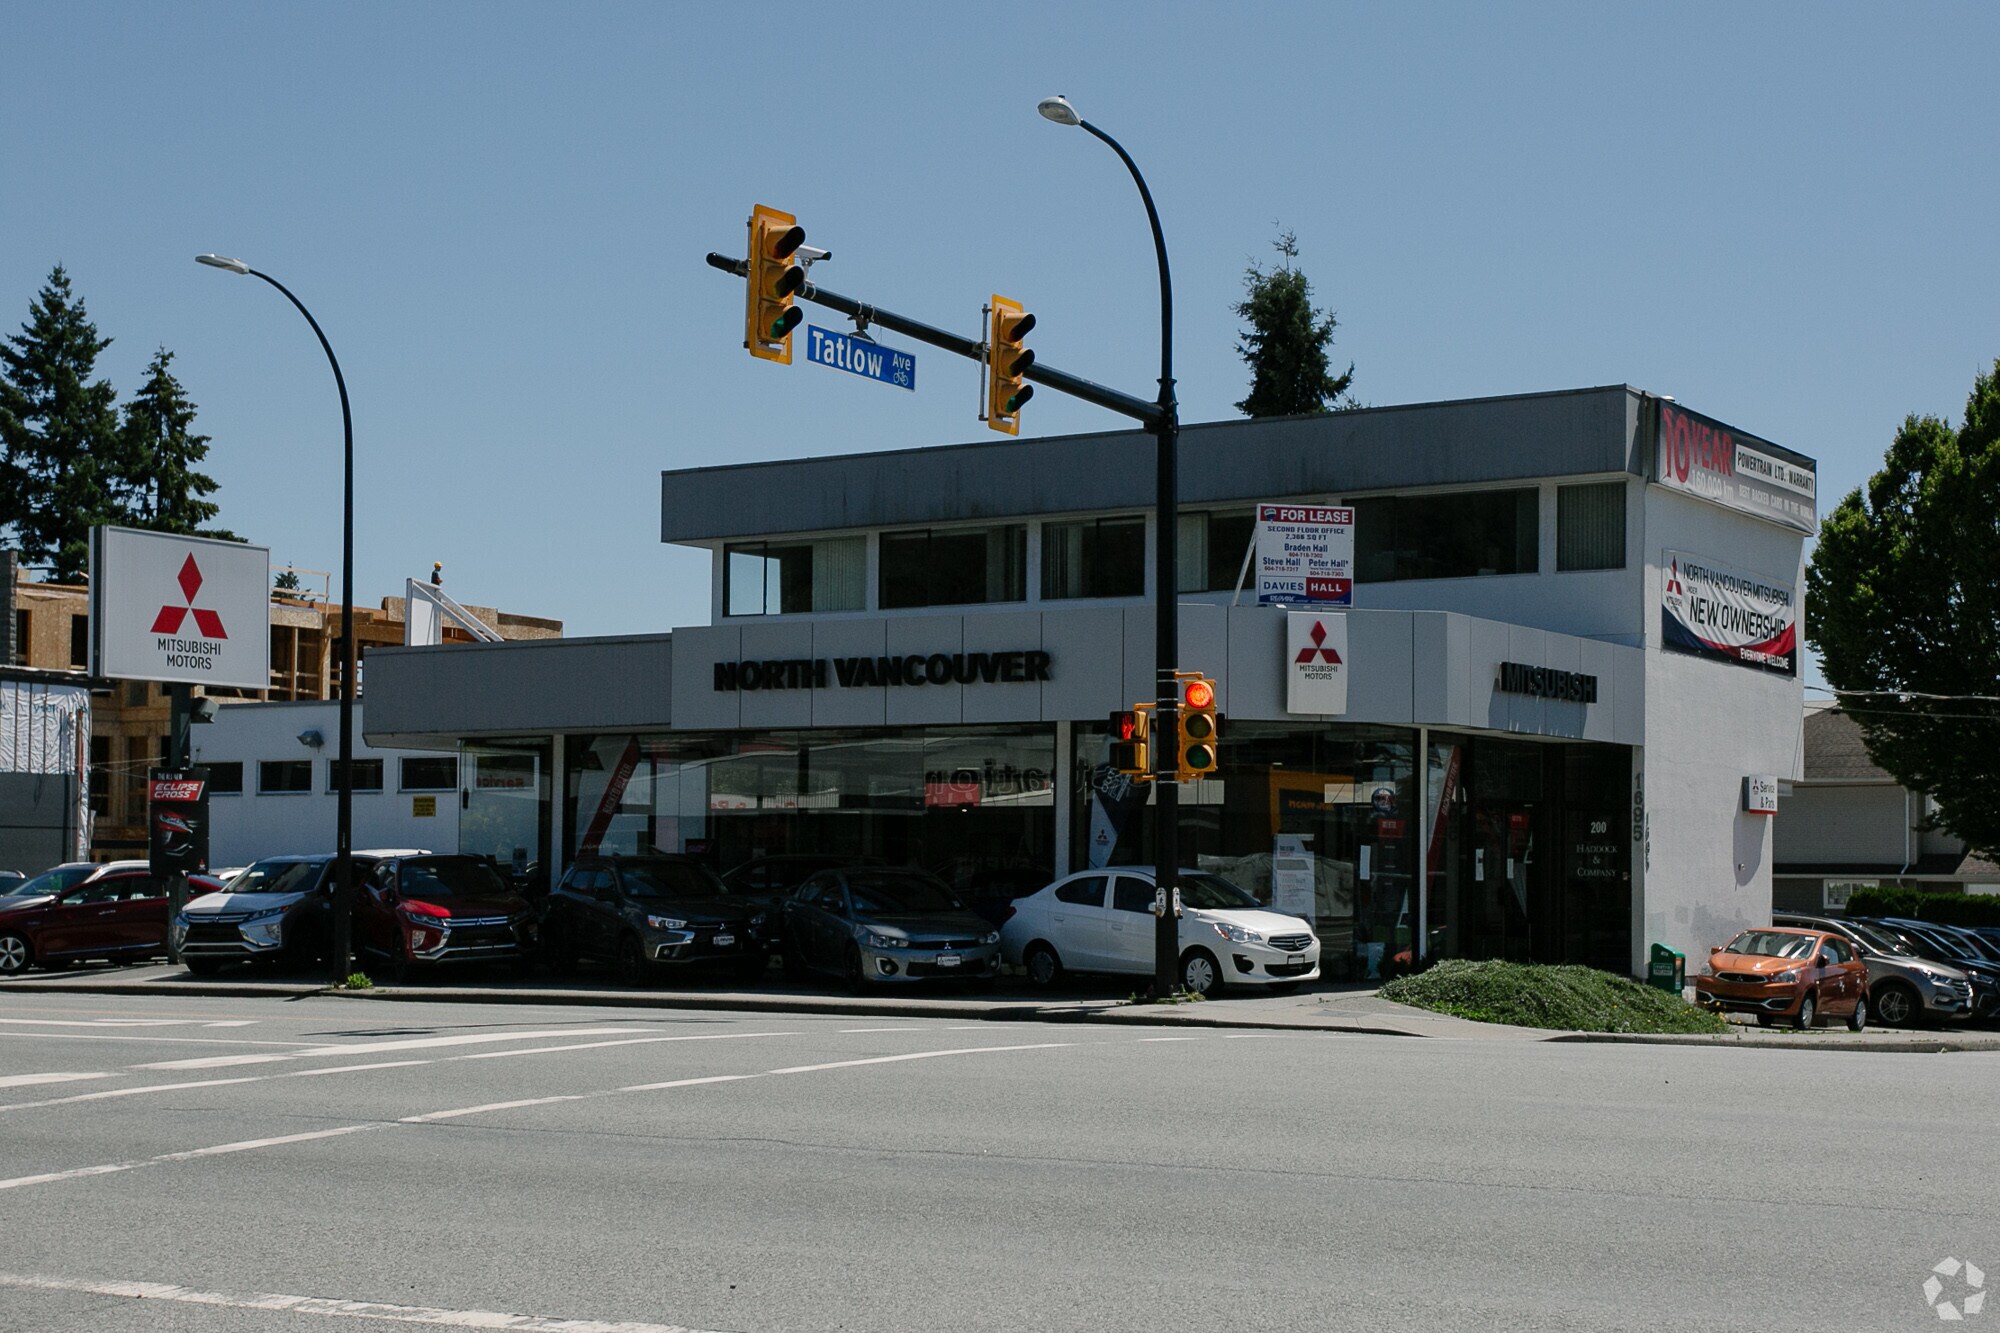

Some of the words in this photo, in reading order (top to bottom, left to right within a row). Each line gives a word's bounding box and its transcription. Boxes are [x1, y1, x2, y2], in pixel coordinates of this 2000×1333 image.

[812, 330, 883, 378] Tatlow
[892, 353, 911, 370] Ave
[1663, 407, 1690, 484] 10
[1691, 419, 1732, 477] YEAR
[1737, 451, 1772, 477] POWERTRAIN
[1774, 462, 1787, 482] LTD.
[1788, 469, 1815, 494] WARRANTY
[1723, 480, 1734, 500] km
[1280, 509, 1306, 520] FOR
[1310, 510, 1349, 522] LEASE
[1284, 543, 1311, 552] Braden
[1312, 544, 1328, 552] Hall
[1262, 557, 1284, 565] Steve
[1286, 557, 1301, 566] Hall
[1308, 558, 1329, 567] Peter
[1263, 581, 1304, 591] DAVIES
[1311, 583, 1342, 592] HALL
[1683, 562, 1709, 586] NORTH
[1708, 571, 1752, 598] VANCOUVER
[1690, 596, 1719, 627] NEW
[1721, 604, 1786, 644] OWNERSHIP
[157, 637, 221, 656] MITSUBISHI
[166, 654, 212, 670] MOTORS
[1740, 648, 1766, 664] EVERYONE
[1766, 653, 1789, 669] WELCOME
[713, 658, 827, 692] NORTH
[833, 650, 1052, 688] VANCOUVER
[1300, 664, 1338, 672] MITSUBISHI
[1304, 672, 1332, 680] MOTORS
[1502, 661, 1598, 704] MITSUBISHI
[155, 783, 199, 791] ECLIPSE
[154, 790, 191, 798] CROSS
[1633, 773, 1643, 842] 1695
[1590, 821, 1607, 834] 200
[1576, 844, 1618, 853] HADDOCK
[1592, 855, 1601, 865] &
[1577, 867, 1617, 878] COMPANY
